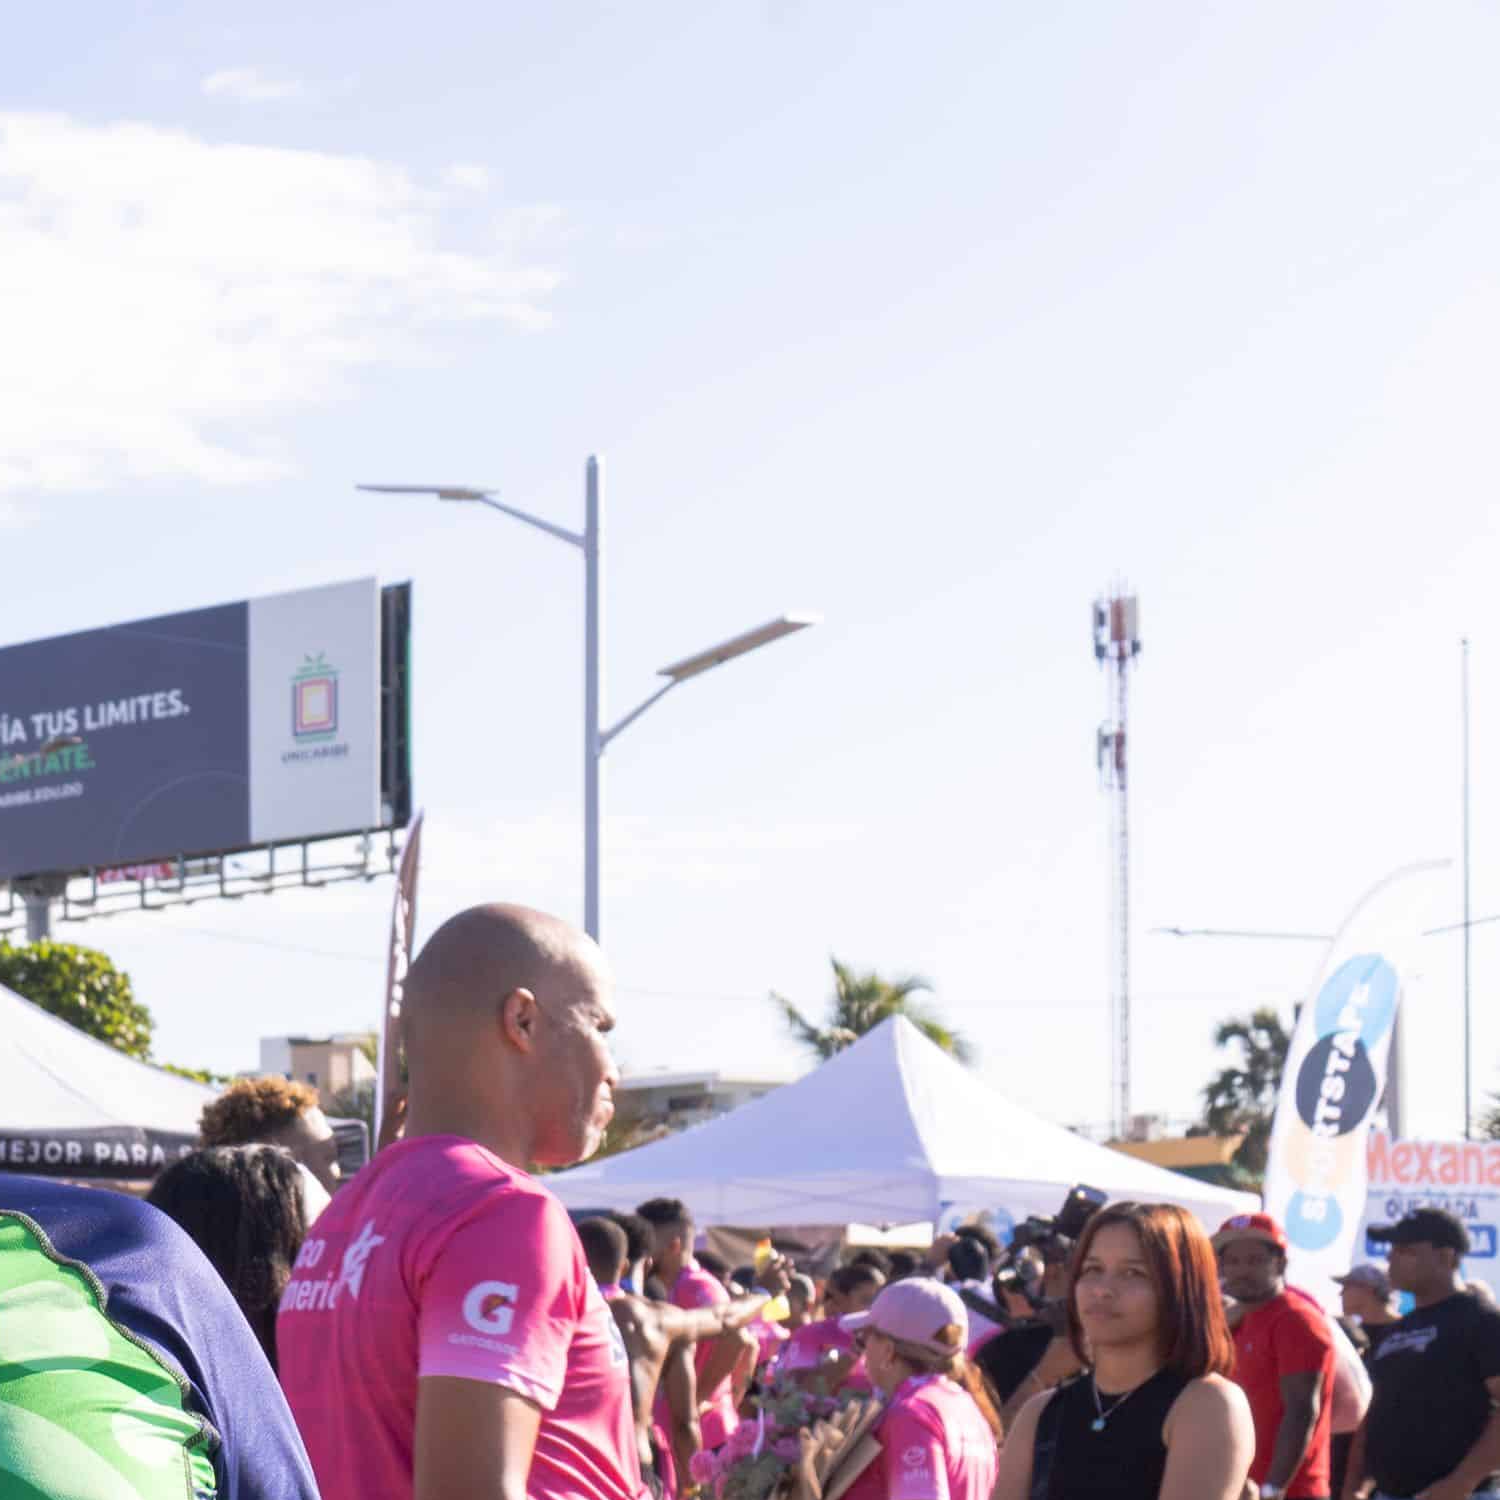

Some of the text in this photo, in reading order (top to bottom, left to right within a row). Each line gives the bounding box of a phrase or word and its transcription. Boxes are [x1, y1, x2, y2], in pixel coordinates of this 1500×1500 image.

[32, 706, 80, 743] TUS
[84, 688, 191, 731] LIMITES.
[94, 1141, 166, 1166] PARA
[463, 1280, 520, 1335] G
